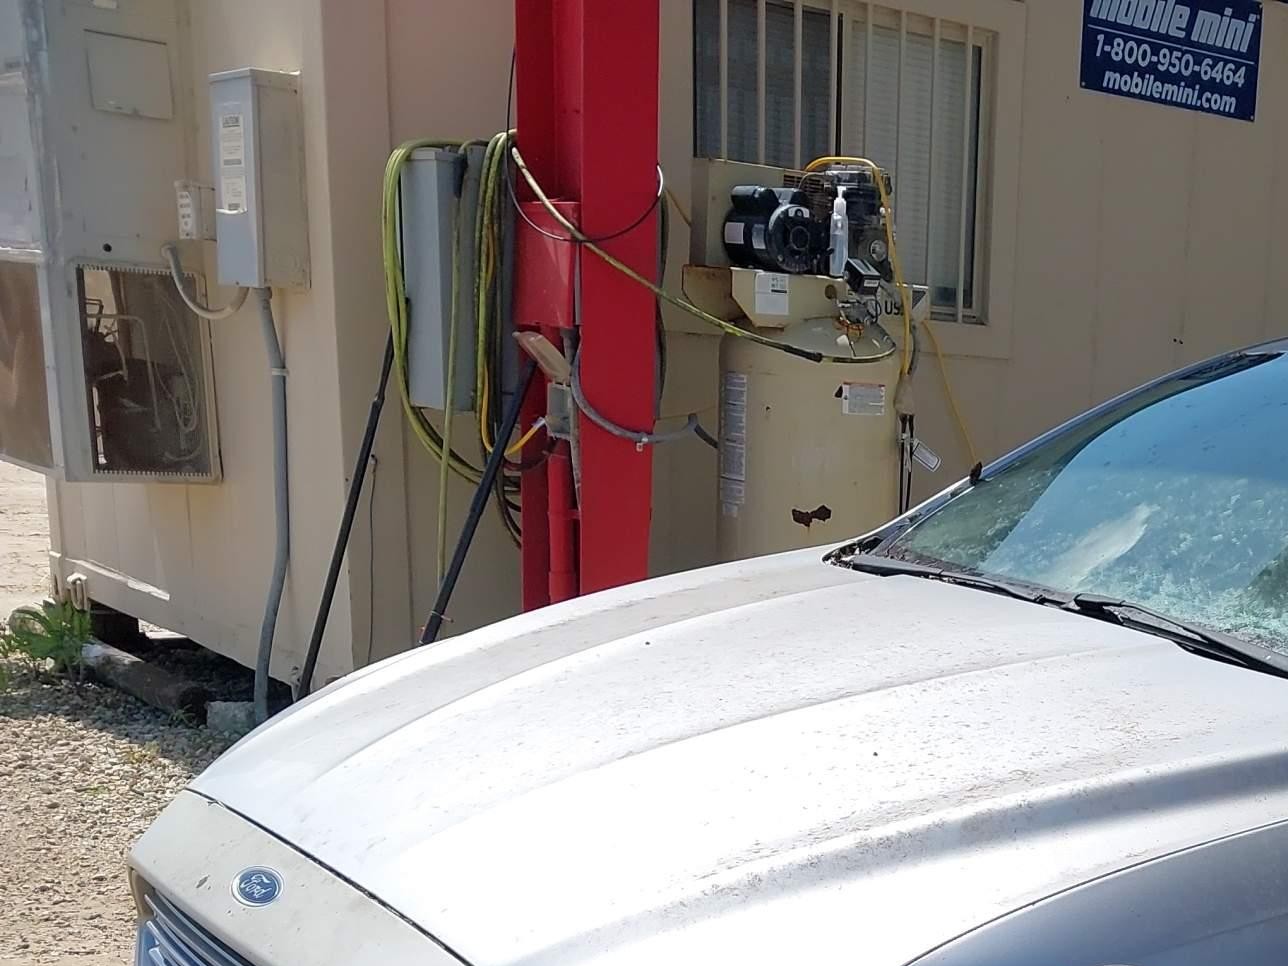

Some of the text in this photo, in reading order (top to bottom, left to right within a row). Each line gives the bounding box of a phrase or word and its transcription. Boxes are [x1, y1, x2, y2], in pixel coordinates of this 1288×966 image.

[1191, 7, 1256, 53] mini
[1096, 34, 1246, 87] 1-800-950-6464
[1103, 71, 1236, 113] mobilemini.com
[240, 874, 272, 899] Ford
